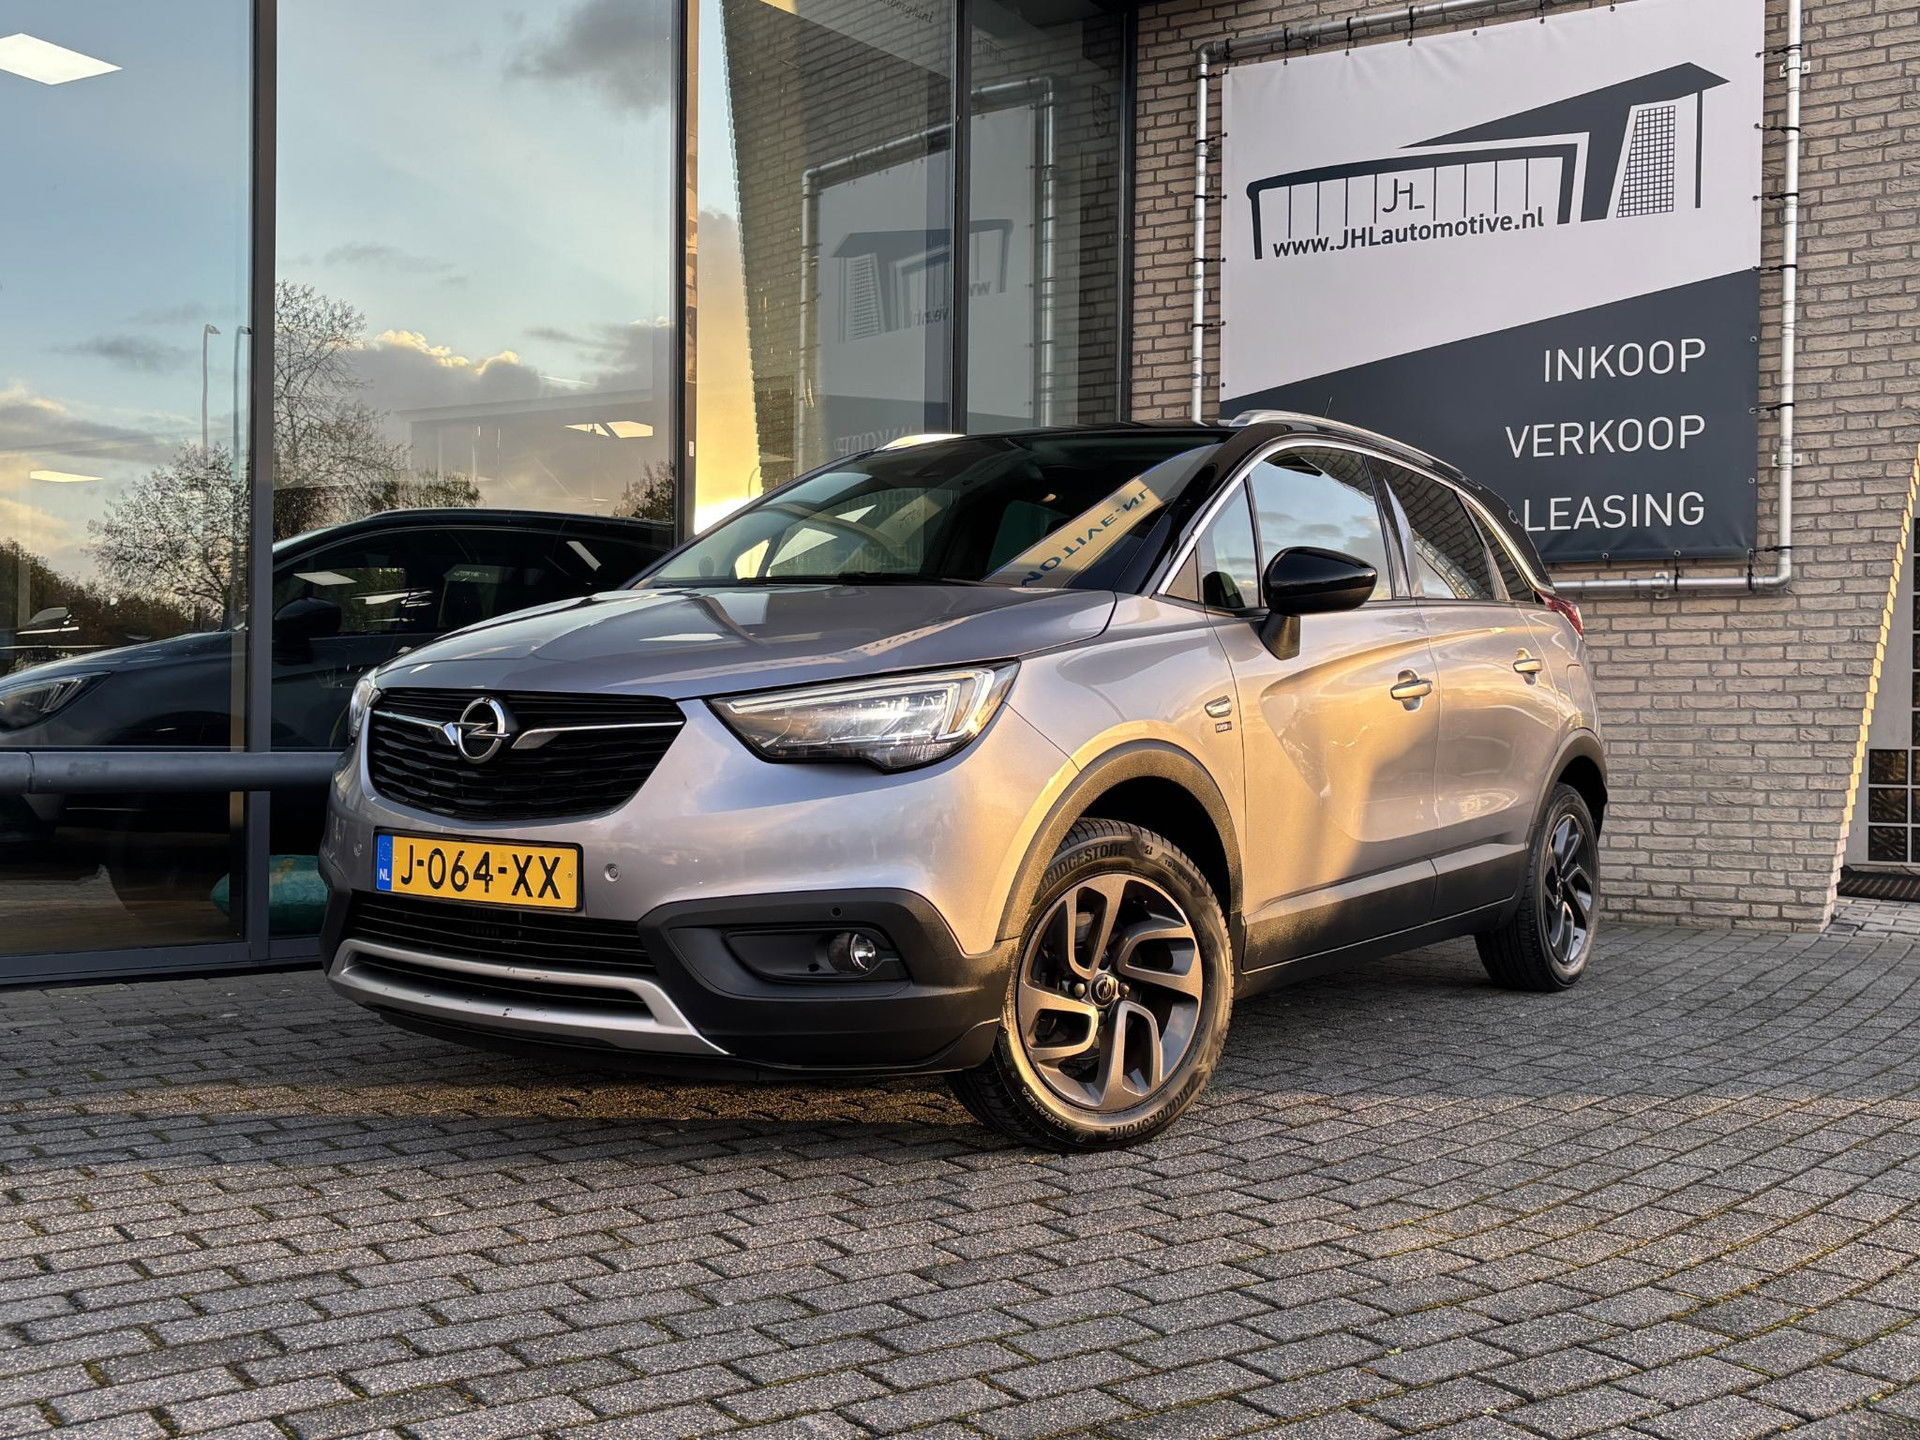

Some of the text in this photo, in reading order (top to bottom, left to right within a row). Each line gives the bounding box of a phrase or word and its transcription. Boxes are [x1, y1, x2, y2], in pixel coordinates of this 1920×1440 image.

[1382, 178, 1425, 213] JHL
[1273, 206, 1544, 258] www.JHLautomotive.nl
[1544, 337, 1706, 383] INKOOP
[1505, 414, 1706, 459] VERKOOP
[1524, 491, 1705, 532] LEASING
[379, 844, 562, 900] NL J-064-XX
